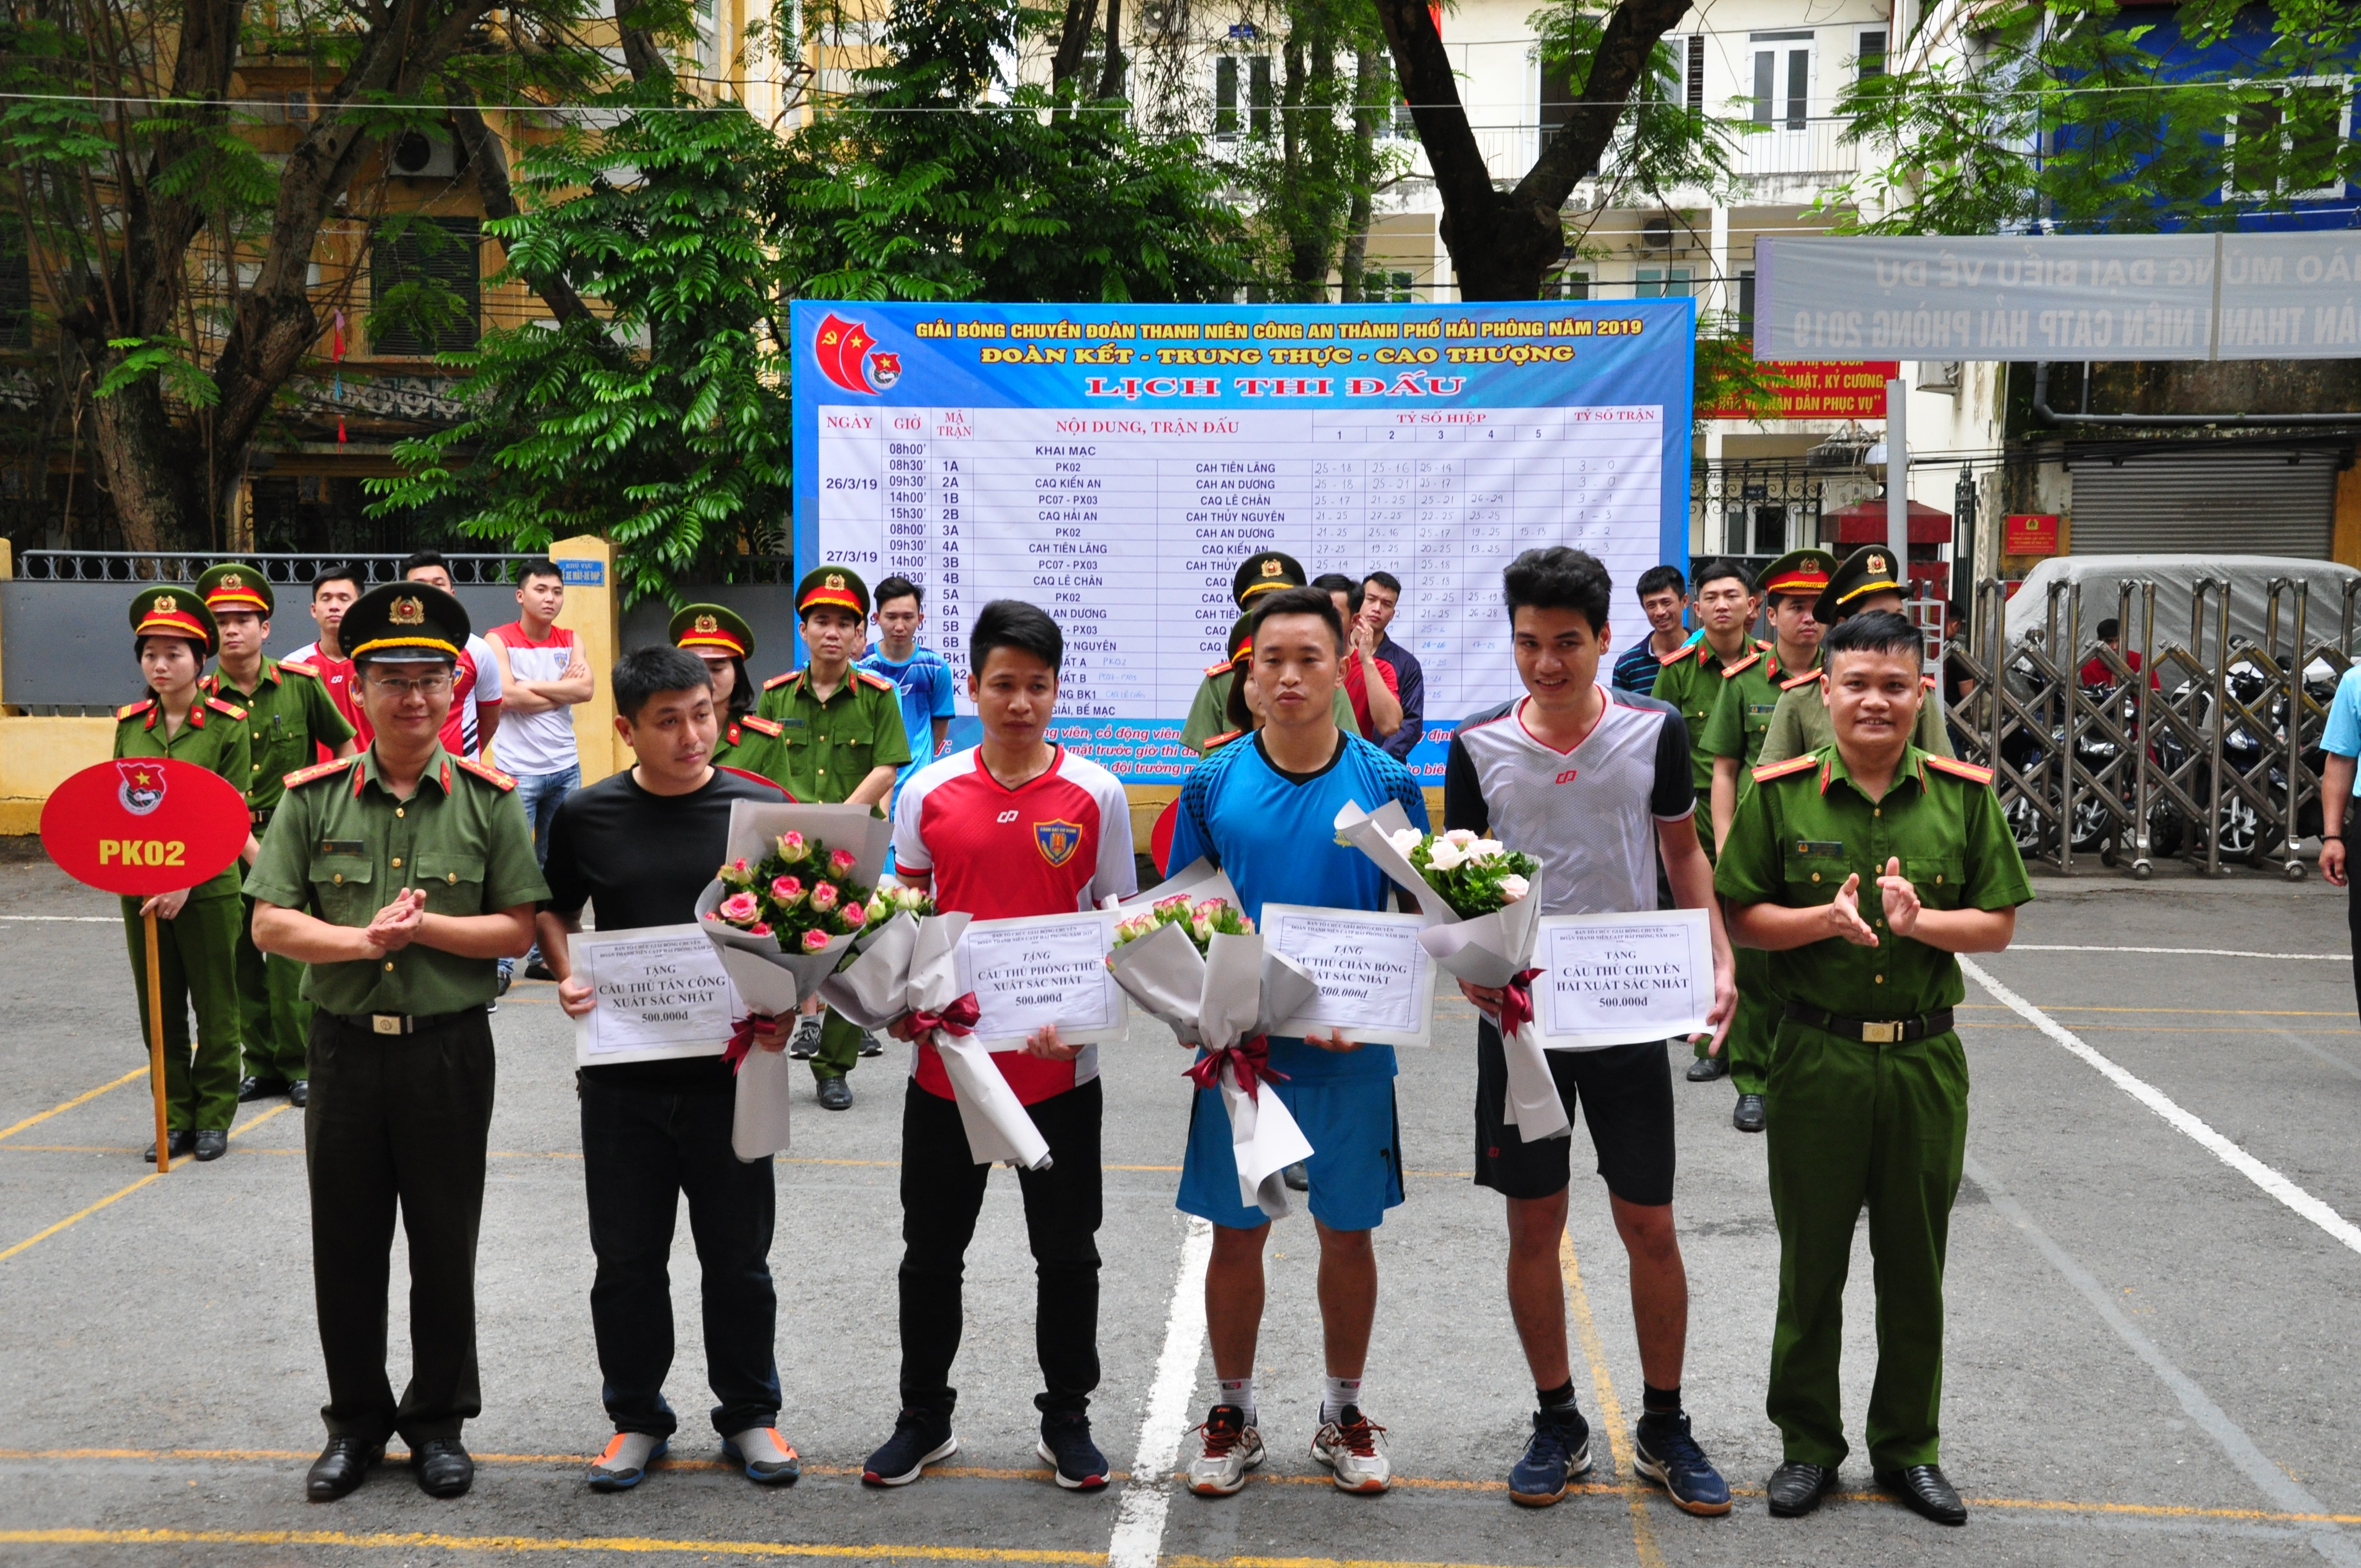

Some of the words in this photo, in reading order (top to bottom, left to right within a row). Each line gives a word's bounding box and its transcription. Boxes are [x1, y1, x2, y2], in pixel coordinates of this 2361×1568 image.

[916, 320, 952, 338] GIẢI
[956, 322, 1005, 338] BÓNG
[1010, 319, 1079, 338] CHUYỀN
[1086, 322, 1135, 338] ĐOÀN
[1140, 323, 1199, 338] THANH
[1204, 322, 1248, 338] NIÊN
[1253, 320, 1303, 338] CÔNG
[1307, 324, 1334, 338] AN
[1339, 322, 1399, 338] THÀNH
[1402, 317, 1441, 338] PHỐ
[1445, 320, 1476, 338] HẢI
[1481, 321, 1544, 337] PHÒNG
[1548, 319, 1591, 336] NĂM
[1596, 319, 1642, 336] 2019
[980, 346, 1066, 364] ĐOÀN
[1073, 342, 1134, 364] KẾT
[1156, 347, 1261, 364] TRUNG
[1269, 345, 1352, 368] THỰC
[1374, 347, 1438, 364] CAO
[1445, 345, 1575, 367] THƯỢNG
[1086, 377, 1221, 400] LỊCH
[1235, 377, 1333, 397] THI
[1345, 370, 1466, 397] ĐẤU
[1825, 369, 1840, 389] KỶ
[1845, 373, 1886, 390] CƯƠNG,
[1796, 394, 1820, 411] DÂN
[1823, 396, 1854, 413] PHỤC
[827, 414, 873, 428] NGÀY
[894, 414, 921, 429] GIỜ
[945, 410, 964, 423] MÃ
[1397, 412, 1416, 424] TỶ
[1421, 410, 1442, 424] SỐ
[1447, 412, 1487, 426] HIỆP
[1574, 409, 1590, 421] TỶ
[1595, 407, 1613, 421] SỐ
[1617, 408, 1655, 424] TRẬN
[937, 422, 972, 439] TRẬN
[1056, 417, 1087, 435] NỘI
[1092, 421, 1146, 434] DUNG,
[1151, 418, 1198, 436] TRẬN
[1203, 416, 1240, 433] ĐẤU
[1337, 431, 1342, 440] 1
[1389, 431, 1394, 440] 2
[1438, 431, 1444, 439] 3
[1488, 430, 1494, 439] 4
[1536, 429, 1541, 438] 5
[1036, 447, 1064, 455] KHAI
[1069, 447, 1096, 457] MẠC
[943, 461, 959, 471] 1A
[1056, 463, 1081, 472] PK02
[1196, 464, 1217, 473] CAH
[1221, 461, 1244, 473] TIÊN
[1247, 461, 1275, 473] LÃNG
[826, 478, 878, 490] 26/3/19
[943, 477, 959, 488] 2A
[1035, 479, 1057, 489] CAQ
[1060, 475, 1084, 488] KIẾN
[1087, 479, 1101, 488] AN
[1196, 480, 1217, 489] CAH
[1221, 480, 1234, 489] AN
[1238, 479, 1275, 489] DƯƠNG
[943, 493, 959, 504] 1B
[1038, 495, 1064, 505] PC07
[1073, 496, 1098, 505] PX03
[1200, 497, 1222, 506] CAQ
[1226, 494, 1238, 505] LÊ
[1242, 494, 1270, 505] CHÂN
[943, 509, 959, 520] 2B
[943, 525, 959, 536] 3A
[943, 541, 959, 552] 4A
[826, 551, 878, 563] 27/3/19
[943, 557, 959, 568] 3B
[943, 573, 959, 584] 4B
[943, 589, 959, 600] 5A
[943, 605, 959, 616] 6A
[943, 622, 959, 632] 5B
[943, 637, 959, 648] 6B
[1062, 727, 1091, 740] viên,
[1096, 725, 1112, 738] cổ
[1116, 727, 1149, 741] động
[1153, 727, 1179, 739] viên
[1069, 745, 1092, 758] mặt
[1097, 744, 1131, 756] trước
[1136, 745, 1158, 758] giờ
[1162, 744, 1177, 756] thi
[1112, 761, 1131, 775] đội
[1136, 761, 1180, 774] trưởng
[100, 840, 185, 865] PK02
[1334, 945, 1363, 956] TẶNG
[1604, 951, 1636, 961] TẶNG
[1022, 951, 1051, 963] TẶNG
[644, 965, 676, 977] TẶNG
[1031, 963, 1070, 976] PHÒNG
[1375, 962, 1407, 974] BÓNG
[688, 975, 725, 987] CÔNG
[1557, 982, 1580, 991] HAI
[1319, 986, 1368, 999] 500.000đ
[1016, 993, 1062, 1006] 500.000đ
[1599, 997, 1648, 1008] 500.000đ
[642, 1011, 688, 1023] 500.000đ
